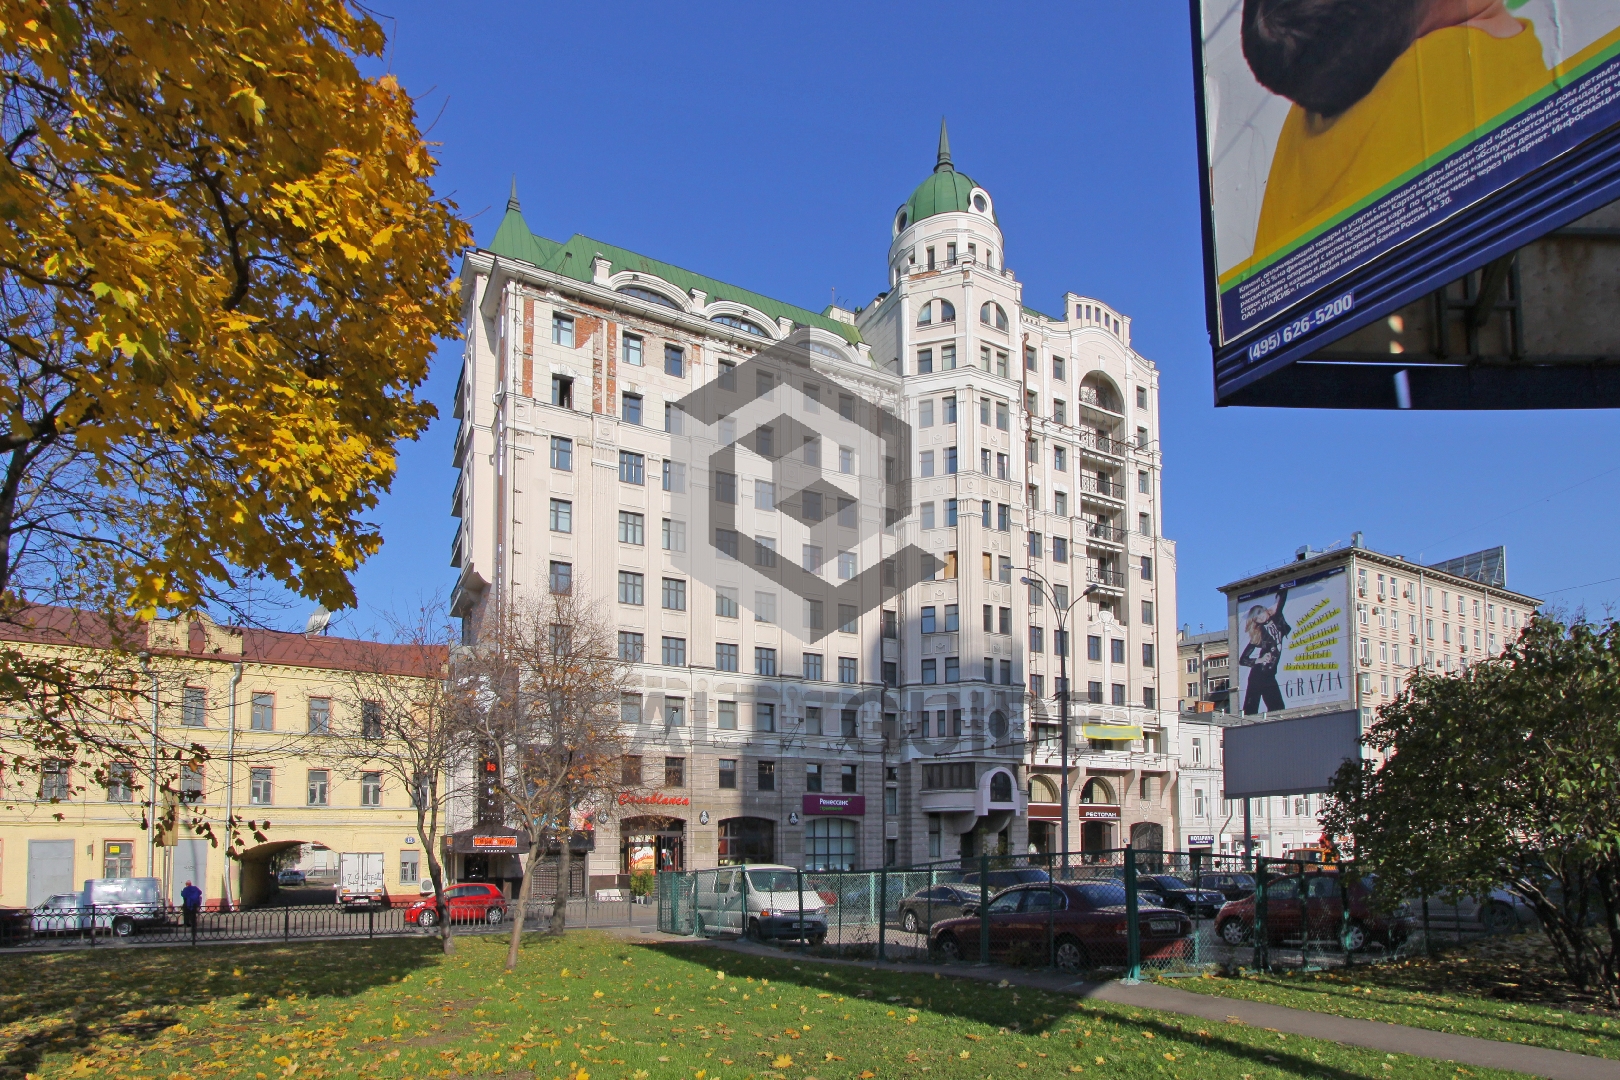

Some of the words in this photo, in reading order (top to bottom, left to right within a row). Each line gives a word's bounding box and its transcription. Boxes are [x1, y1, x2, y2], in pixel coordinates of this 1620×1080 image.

[1239, 277, 1262, 293] Клиент,
[1263, 245, 1314, 278] оплачивающий
[1315, 229, 1340, 247] товары
[1348, 210, 1371, 229] услуги
[1378, 184, 1416, 210] помощью
[1419, 168, 1443, 186] карты
[1445, 136, 1492, 170] MasterCard
[1495, 101, 1553, 139] «Достойный
[1555, 88, 1575, 106] дом
[1578, 62, 1619, 92] детям!»
[1260, 277, 1270, 287] 0,5
[1286, 235, 1343, 273] финансирование
[1391, 193, 1414, 210] Карта
[1416, 162, 1467, 196] выпускается
[1476, 116, 1544, 160] обслуживается
[1326, 218, 1386, 257] использованием
[1388, 207, 1405, 221] карт
[1422, 170, 1468, 201] получению
[1471, 142, 1515, 171] наличных
[1517, 111, 1568, 146] денежных
[1571, 86, 1610, 113] средств
[1241, 299, 1260, 313] ставок
[1267, 286, 1282, 300] пари
[1289, 269, 1312, 286] казино
[1319, 251, 1342, 270] других
[1344, 232, 1375, 254] игорных
[1433, 190, 1448, 202] том
[1451, 175, 1475, 191] числе
[1477, 160, 1501, 176] через
[1503, 133, 1549, 162] Интернет.
[1241, 308, 1256, 320] ОАО
[1296, 261, 1339, 289] Генеральная
[1340, 241, 1375, 264] лицензия
[1377, 227, 1399, 244] Банка
[1401, 210, 1428, 229] России
[1440, 196, 1451, 208] 30.
[1249, 332, 1280, 360] (495)
[1284, 294, 1352, 342] 626-5200
[1295, 649, 1330, 661] ОТКРЫТ
[1306, 637, 1336, 652] СЕЗОН
[1286, 671, 1342, 698] GRAZIA
[618, 790, 690, 806] Casablanca
[819, 798, 849, 806] Ренессанс
